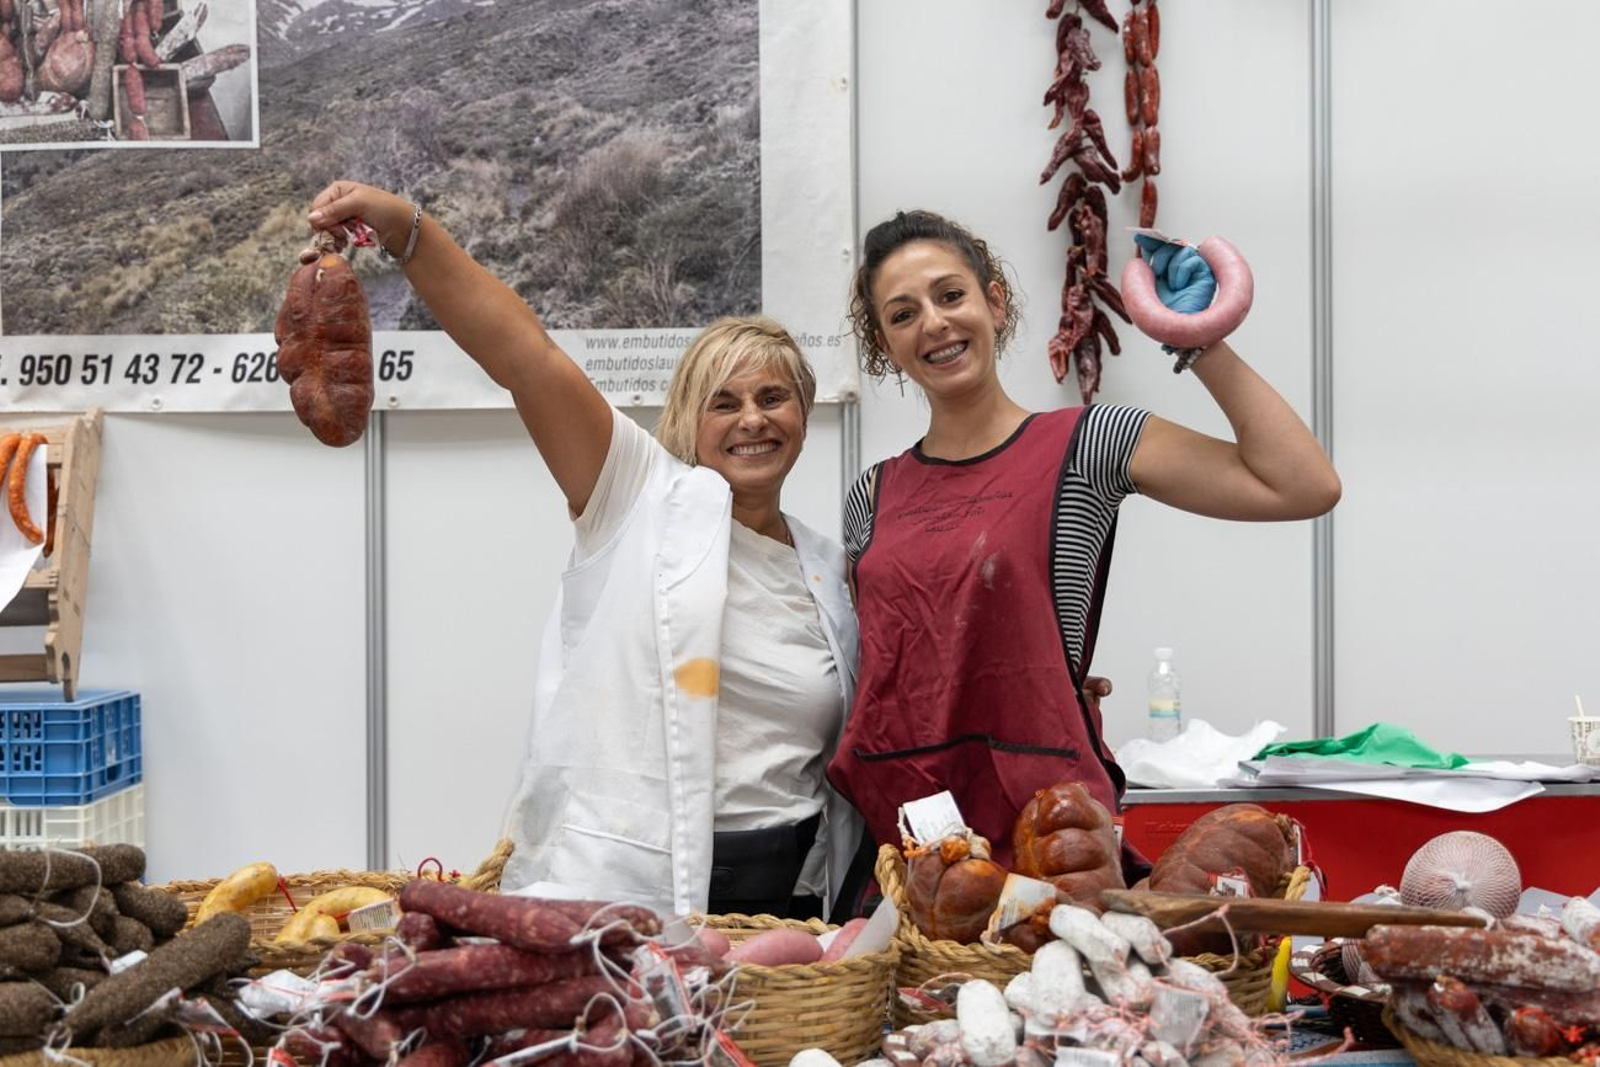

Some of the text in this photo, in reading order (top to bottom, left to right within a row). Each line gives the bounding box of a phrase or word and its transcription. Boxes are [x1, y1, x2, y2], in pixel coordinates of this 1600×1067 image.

[19, 354, 72, 386] 950
[81, 354, 113, 385] 51
[124, 353, 160, 384] 43
[171, 353, 204, 384] 72
[379, 350, 414, 381] 65
[585, 355, 678, 371] embutidoslau
